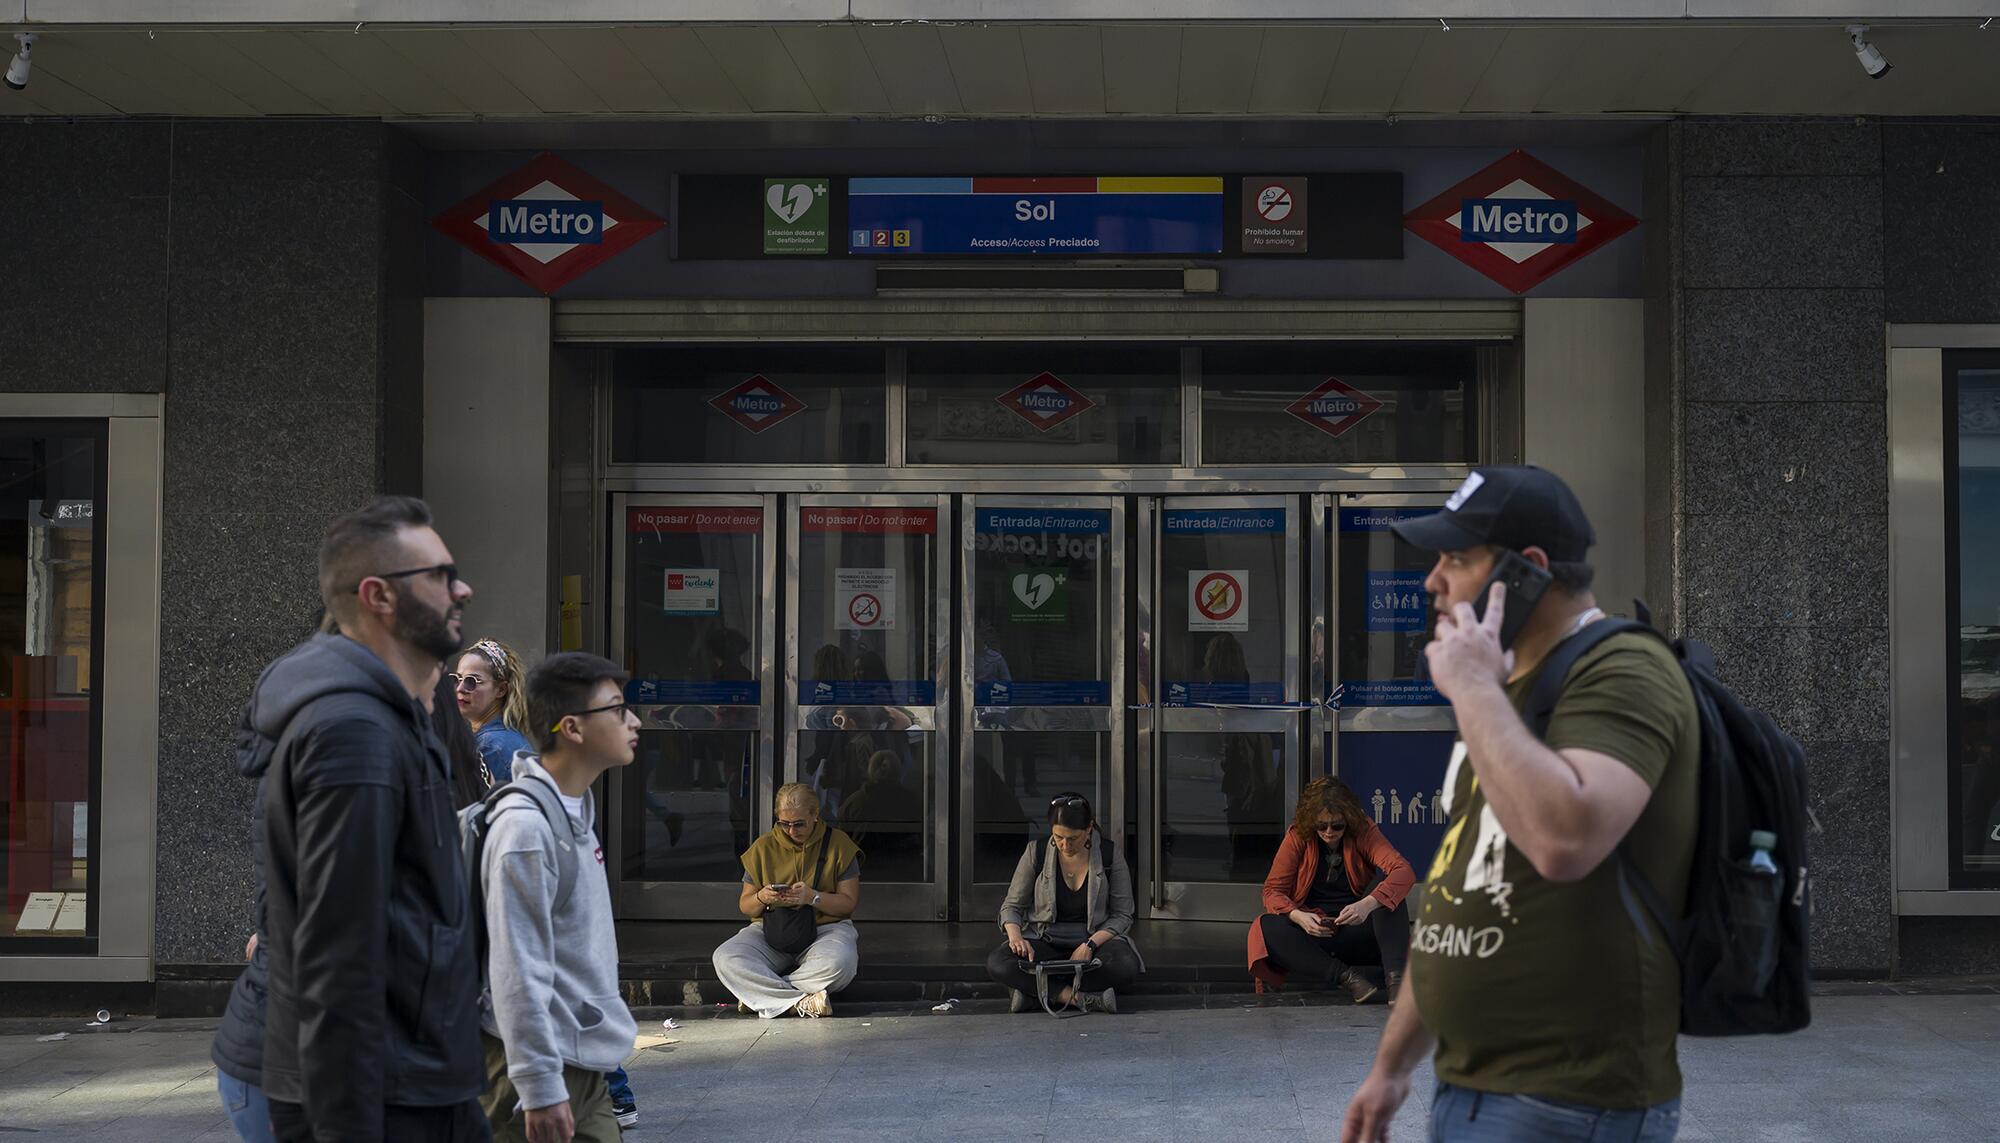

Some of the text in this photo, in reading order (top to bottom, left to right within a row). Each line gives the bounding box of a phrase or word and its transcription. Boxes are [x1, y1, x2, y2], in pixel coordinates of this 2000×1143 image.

[1015, 199, 1055, 221] Sol
[499, 206, 594, 235] Metro
[1472, 205, 1569, 234] Metro
[858, 232, 865, 245] 1
[877, 232, 886, 245] 2
[897, 232, 906, 245] 3
[1245, 228, 1304, 236] Prohibido fumar
[970, 237, 1100, 248] Acceso/Access Preciados
[1264, 238, 1295, 247] smoking
[736, 396, 778, 411] Metro
[1024, 394, 1066, 408] Metro
[1313, 400, 1355, 413] Metro
[637, 513, 654, 524] No
[656, 515, 688, 526] pasar
[695, 513, 711, 525] Do
[713, 514, 730, 525] not
[732, 514, 761, 525] enter
[808, 514, 824, 524] No
[826, 515, 857, 526] pasar
[864, 514, 879, 525] Do
[881, 514, 898, 525] not
[900, 515, 928, 525] enter
[989, 515, 1099, 528] Entrada/Entrance
[1167, 516, 1275, 529] Entrada/Entrance
[1370, 578, 1420, 587] Uso preferente
